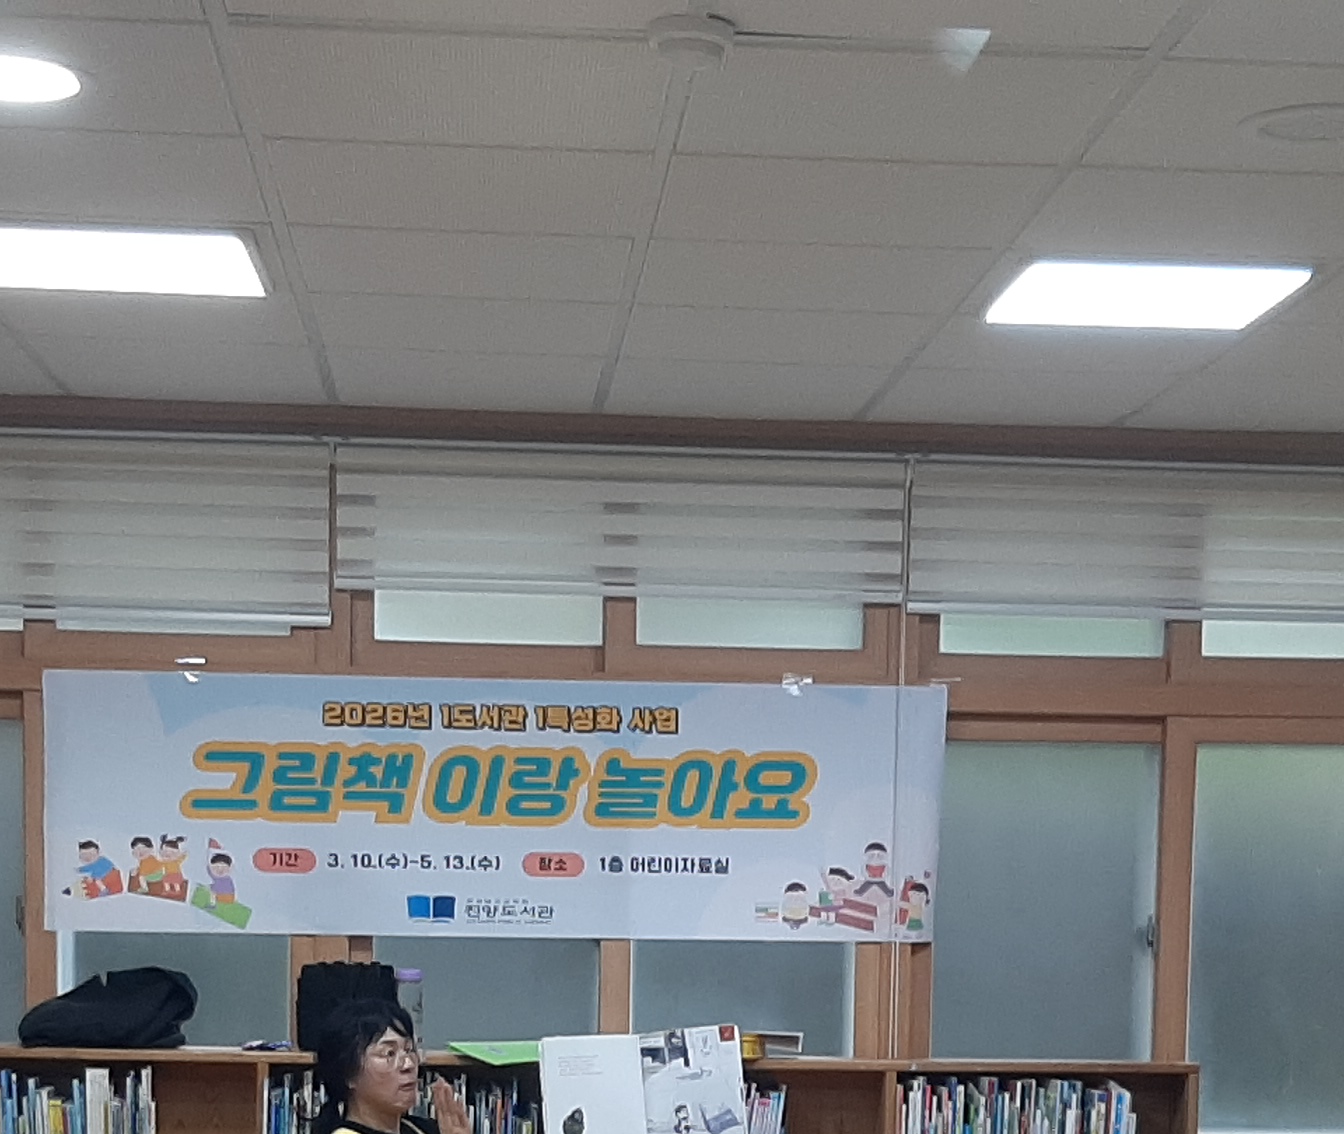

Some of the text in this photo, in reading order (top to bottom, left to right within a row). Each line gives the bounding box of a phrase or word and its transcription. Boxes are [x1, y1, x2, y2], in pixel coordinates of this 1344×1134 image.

[322, 701, 679, 733] 2026년 1도서관 1특성화 사업
[187, 747, 811, 822] 그림책 이랑 놀아요
[268, 852, 300, 868] 기간
[538, 856, 567, 872] 장소
[599, 855, 730, 875] 1층 어린이자료실
